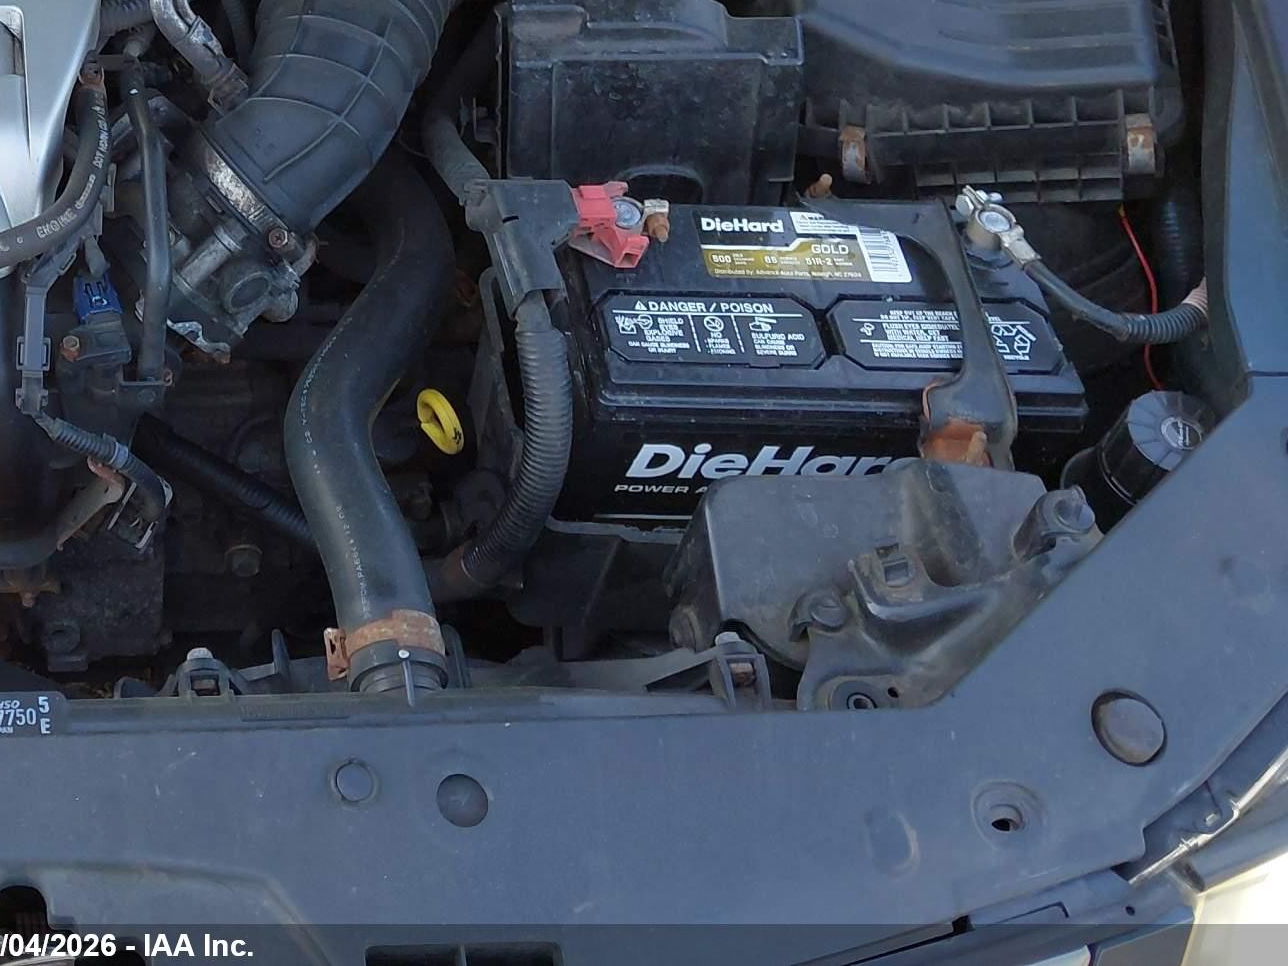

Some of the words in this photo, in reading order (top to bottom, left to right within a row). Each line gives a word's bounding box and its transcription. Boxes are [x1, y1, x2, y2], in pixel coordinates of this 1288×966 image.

[700, 217, 785, 233] DieHard
[811, 244, 849, 255] GOLD
[648, 301, 707, 312] DANGER
[710, 302, 717, 312] /
[720, 302, 774, 313] POISON
[614, 484, 689, 494] POWER
[38, 696, 50, 713] 5
[40, 718, 51, 734] E
